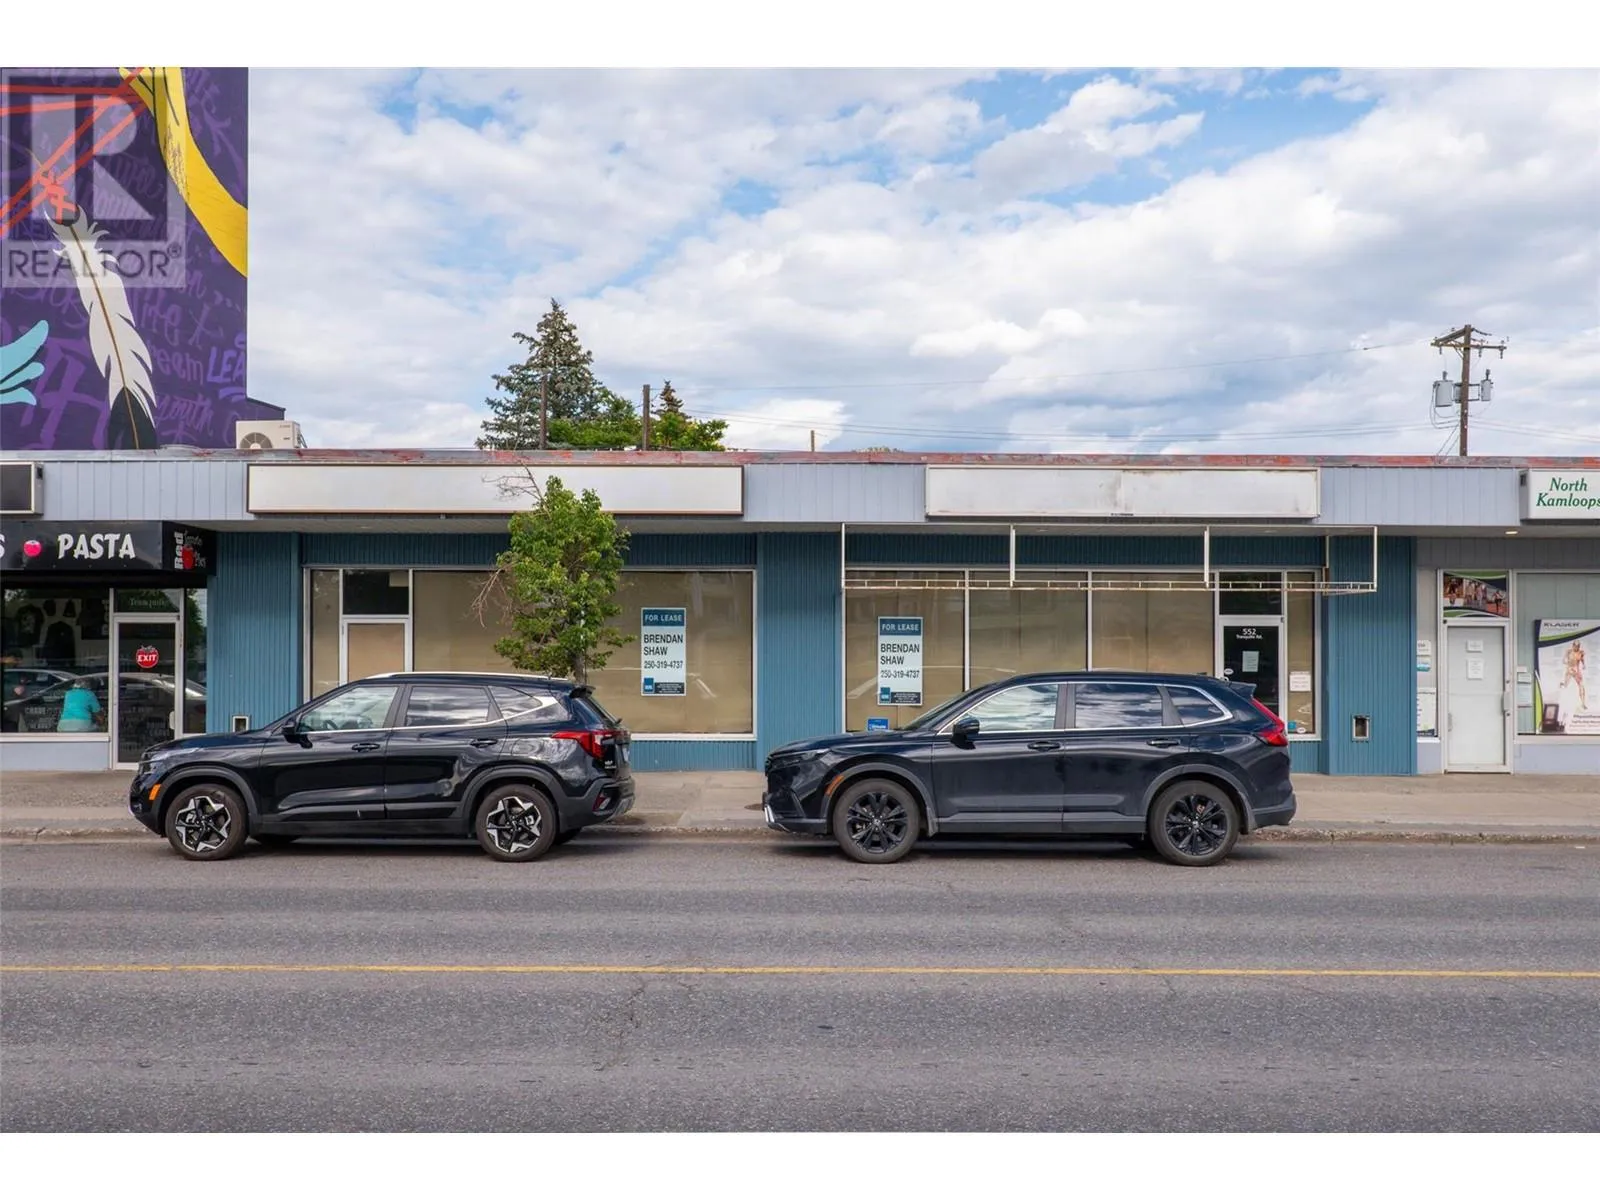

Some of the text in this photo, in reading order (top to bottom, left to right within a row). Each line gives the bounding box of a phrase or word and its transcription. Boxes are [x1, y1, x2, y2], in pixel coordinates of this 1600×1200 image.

[1549, 477, 1588, 491] North
[57, 533, 137, 560] PASTA
[645, 614, 682, 622] FOR LEASE
[881, 623, 920, 632] FOR LEASE
[1242, 628, 1257, 636] 552
[643, 634, 683, 643] BRENDAN
[643, 646, 668, 656] SHAW
[880, 643, 920, 653] BRENDAN
[137, 653, 157, 662] EXIT
[880, 655, 905, 665] SHAW
[643, 660, 684, 669] 250-319-4737
[880, 670, 920, 679] 250-319-4737
